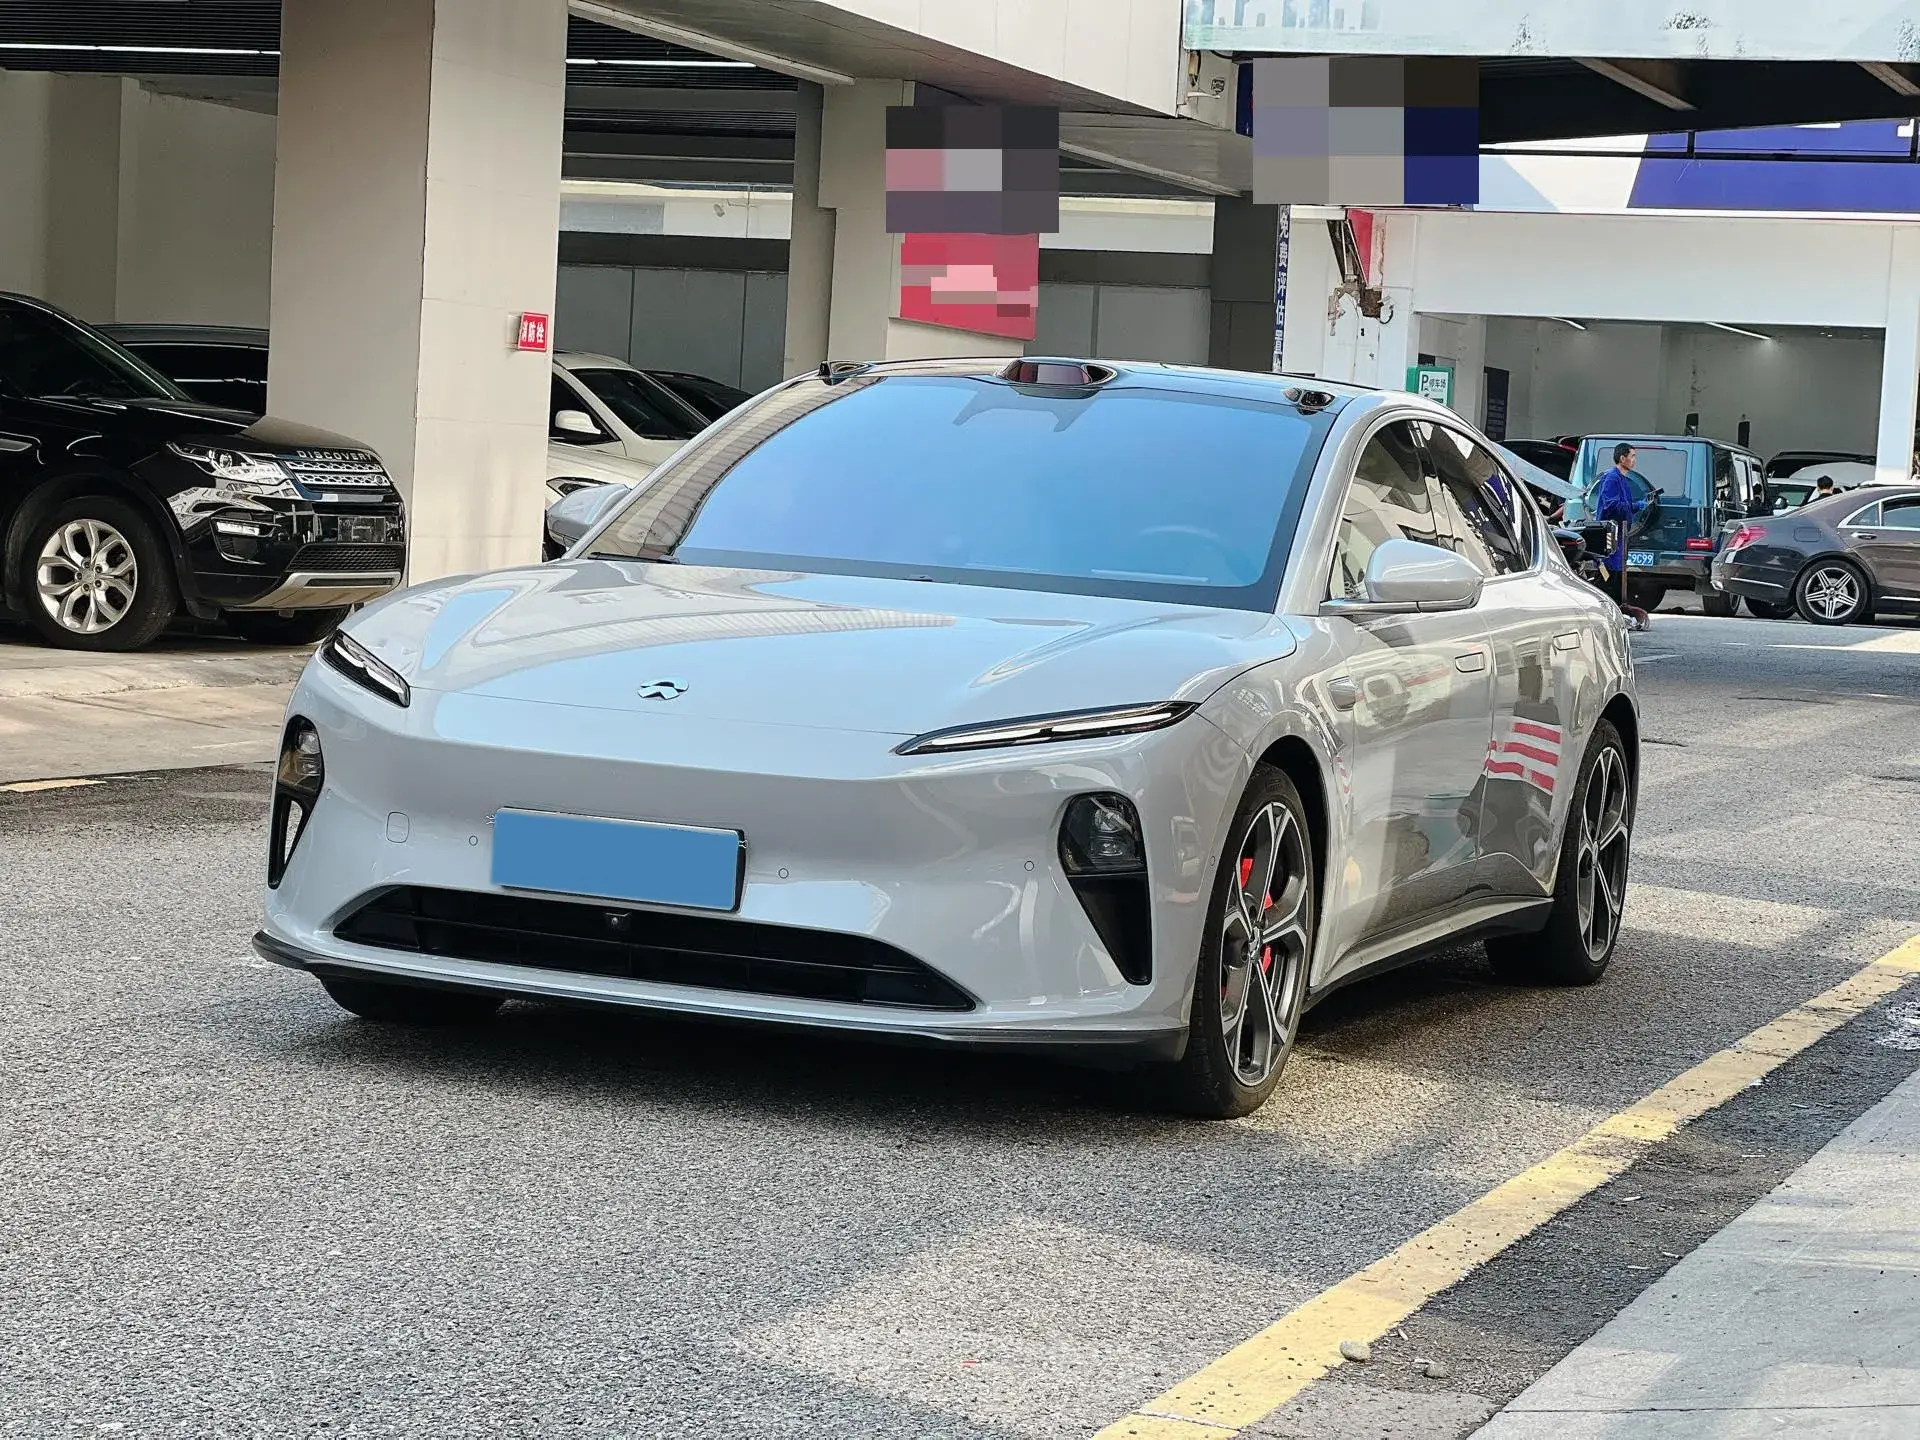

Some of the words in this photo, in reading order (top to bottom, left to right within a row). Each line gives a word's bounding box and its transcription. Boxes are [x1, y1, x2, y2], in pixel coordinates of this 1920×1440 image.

[521, 320, 545, 343] 消防栓
[1421, 374, 1429, 392] P
[1429, 378, 1447, 389] 停车场
[296, 450, 372, 460] DISCOVERY
